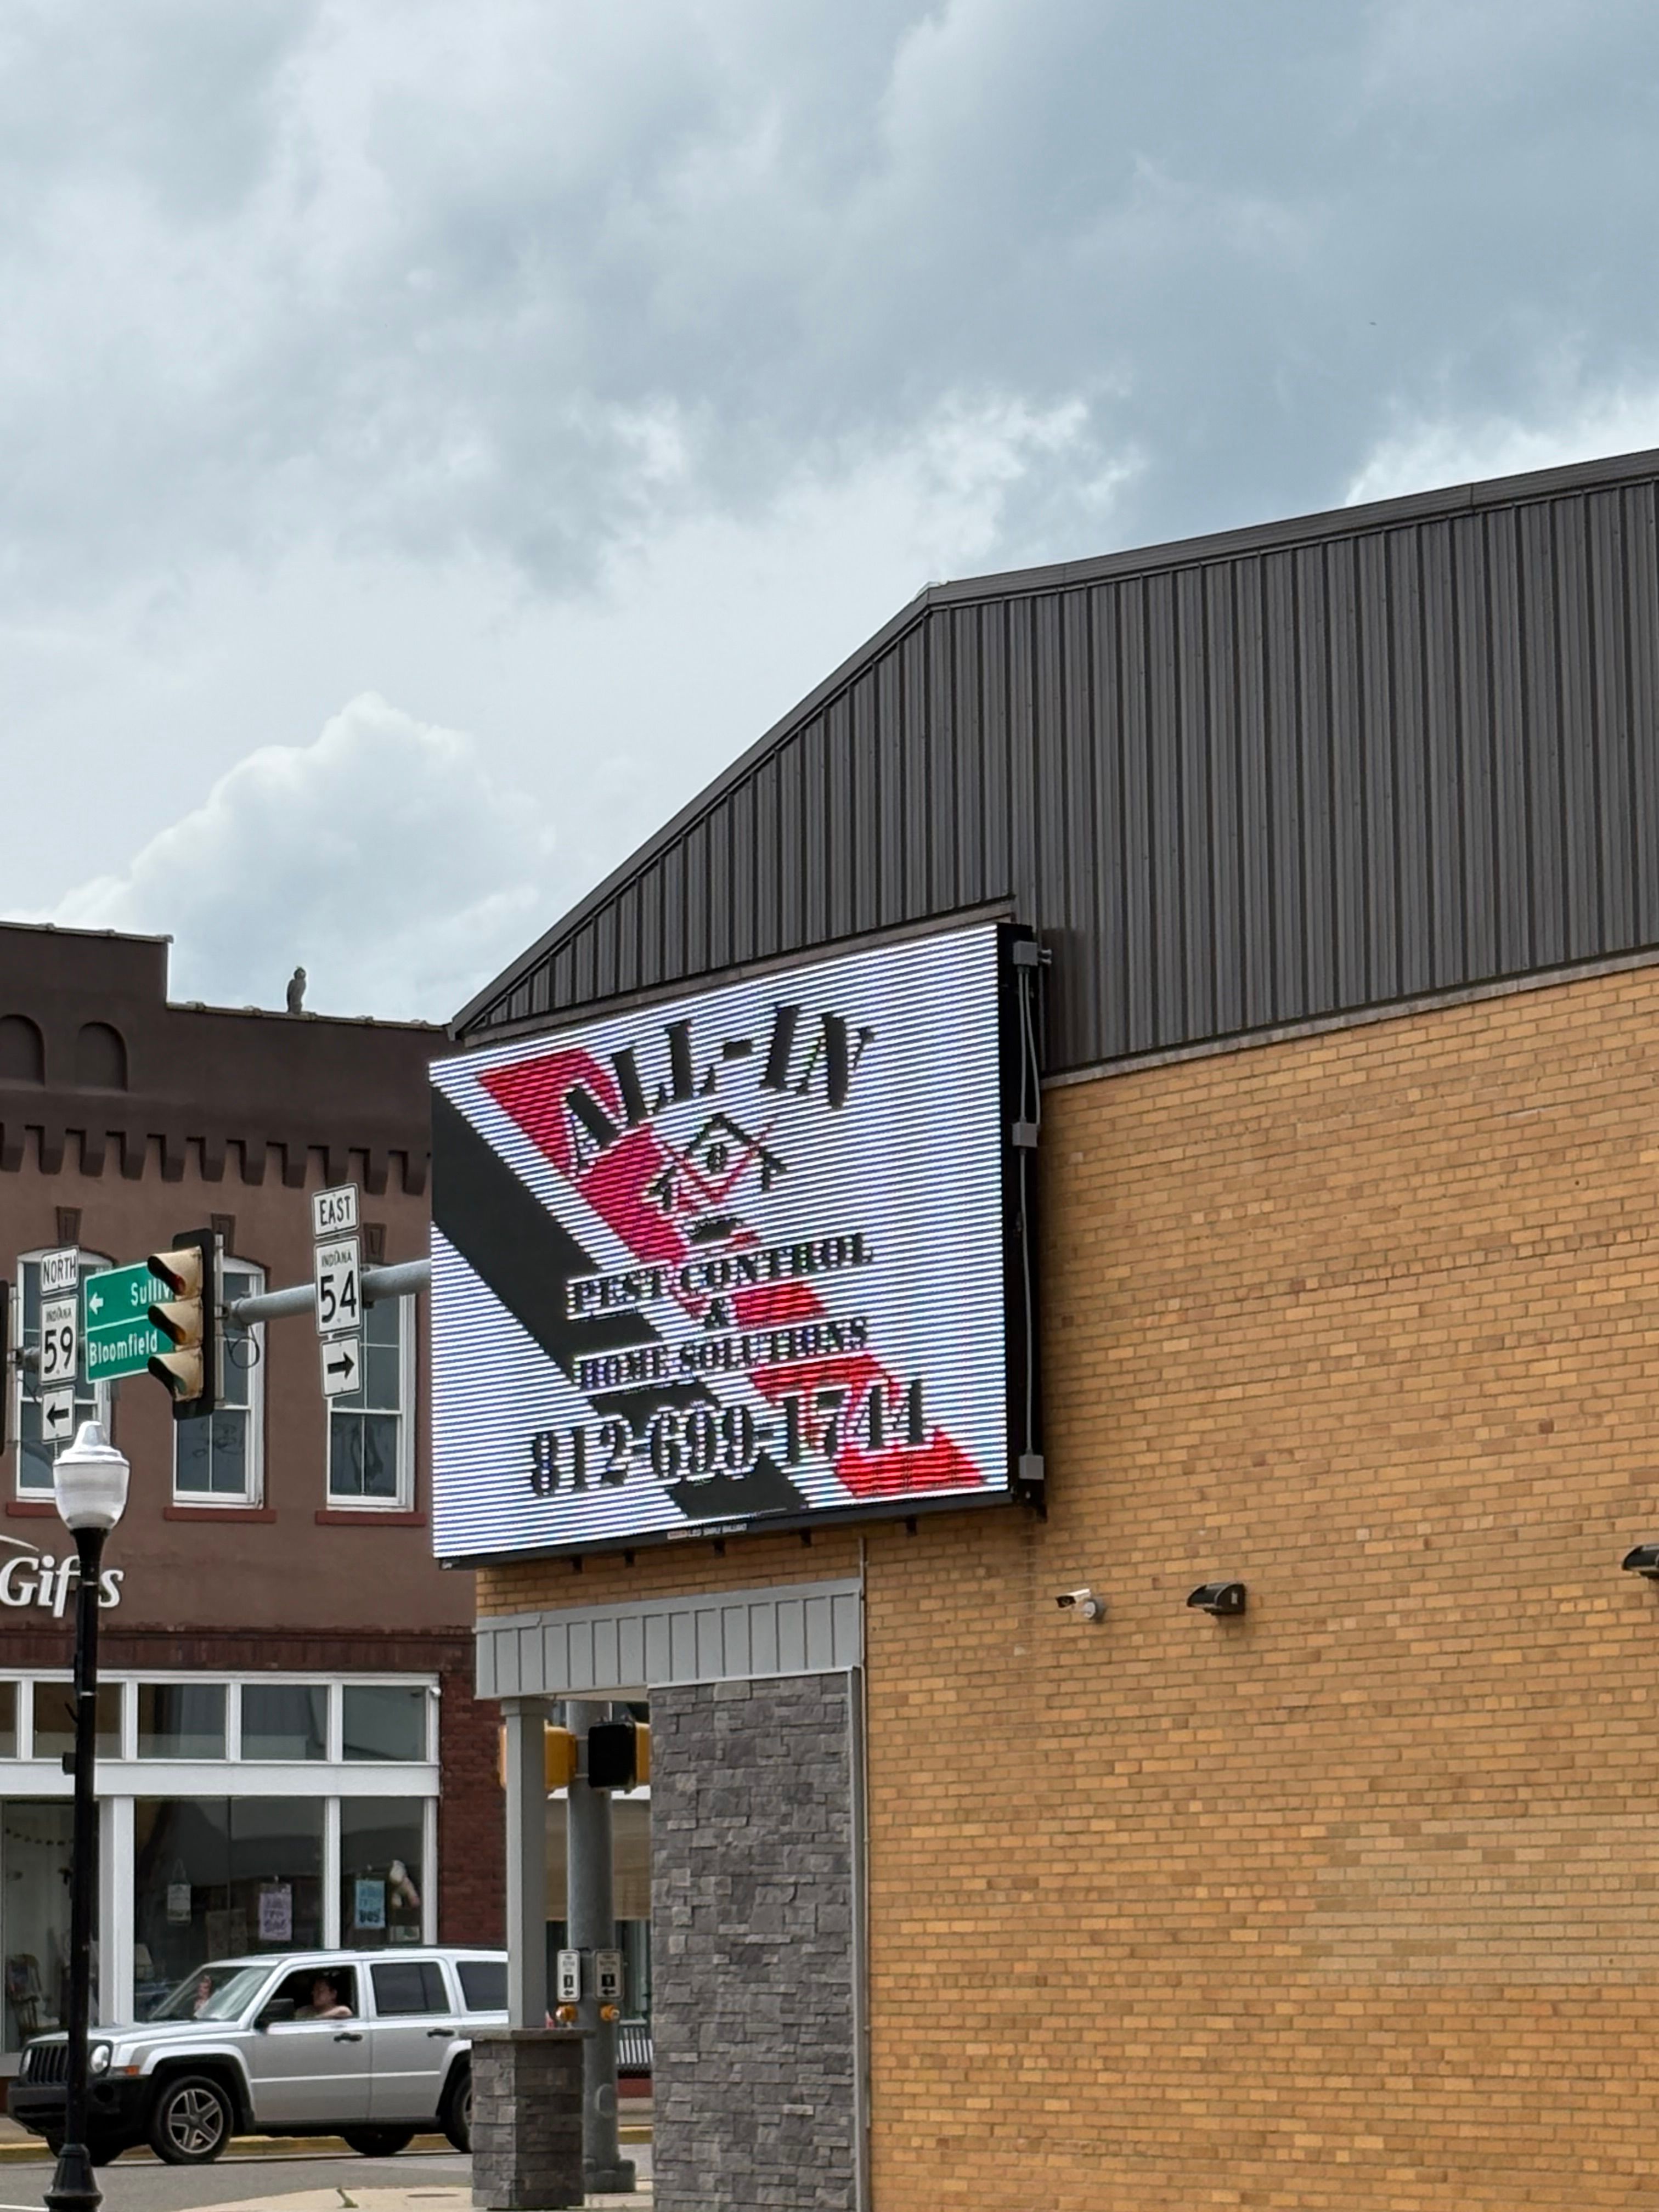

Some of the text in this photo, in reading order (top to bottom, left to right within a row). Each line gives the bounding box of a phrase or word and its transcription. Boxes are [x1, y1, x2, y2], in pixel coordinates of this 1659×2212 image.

[565, 1005, 875, 1171] ALL-IN
[319, 1195, 351, 1226] EAST
[43, 1255, 76, 1285] NORTH
[321, 1250, 352, 1268] INDIANA
[573, 1233, 873, 1314] PEST CONTROL
[131, 1278, 172, 1306] Sulliv
[320, 1270, 357, 1323] 54
[706, 1296, 731, 1329] &
[44, 1326, 73, 1374] 59
[89, 1329, 157, 1367] Bloomfield
[579, 1317, 867, 1390] HOME SOLUTIONS
[0, 1555, 124, 1617] Gifs
